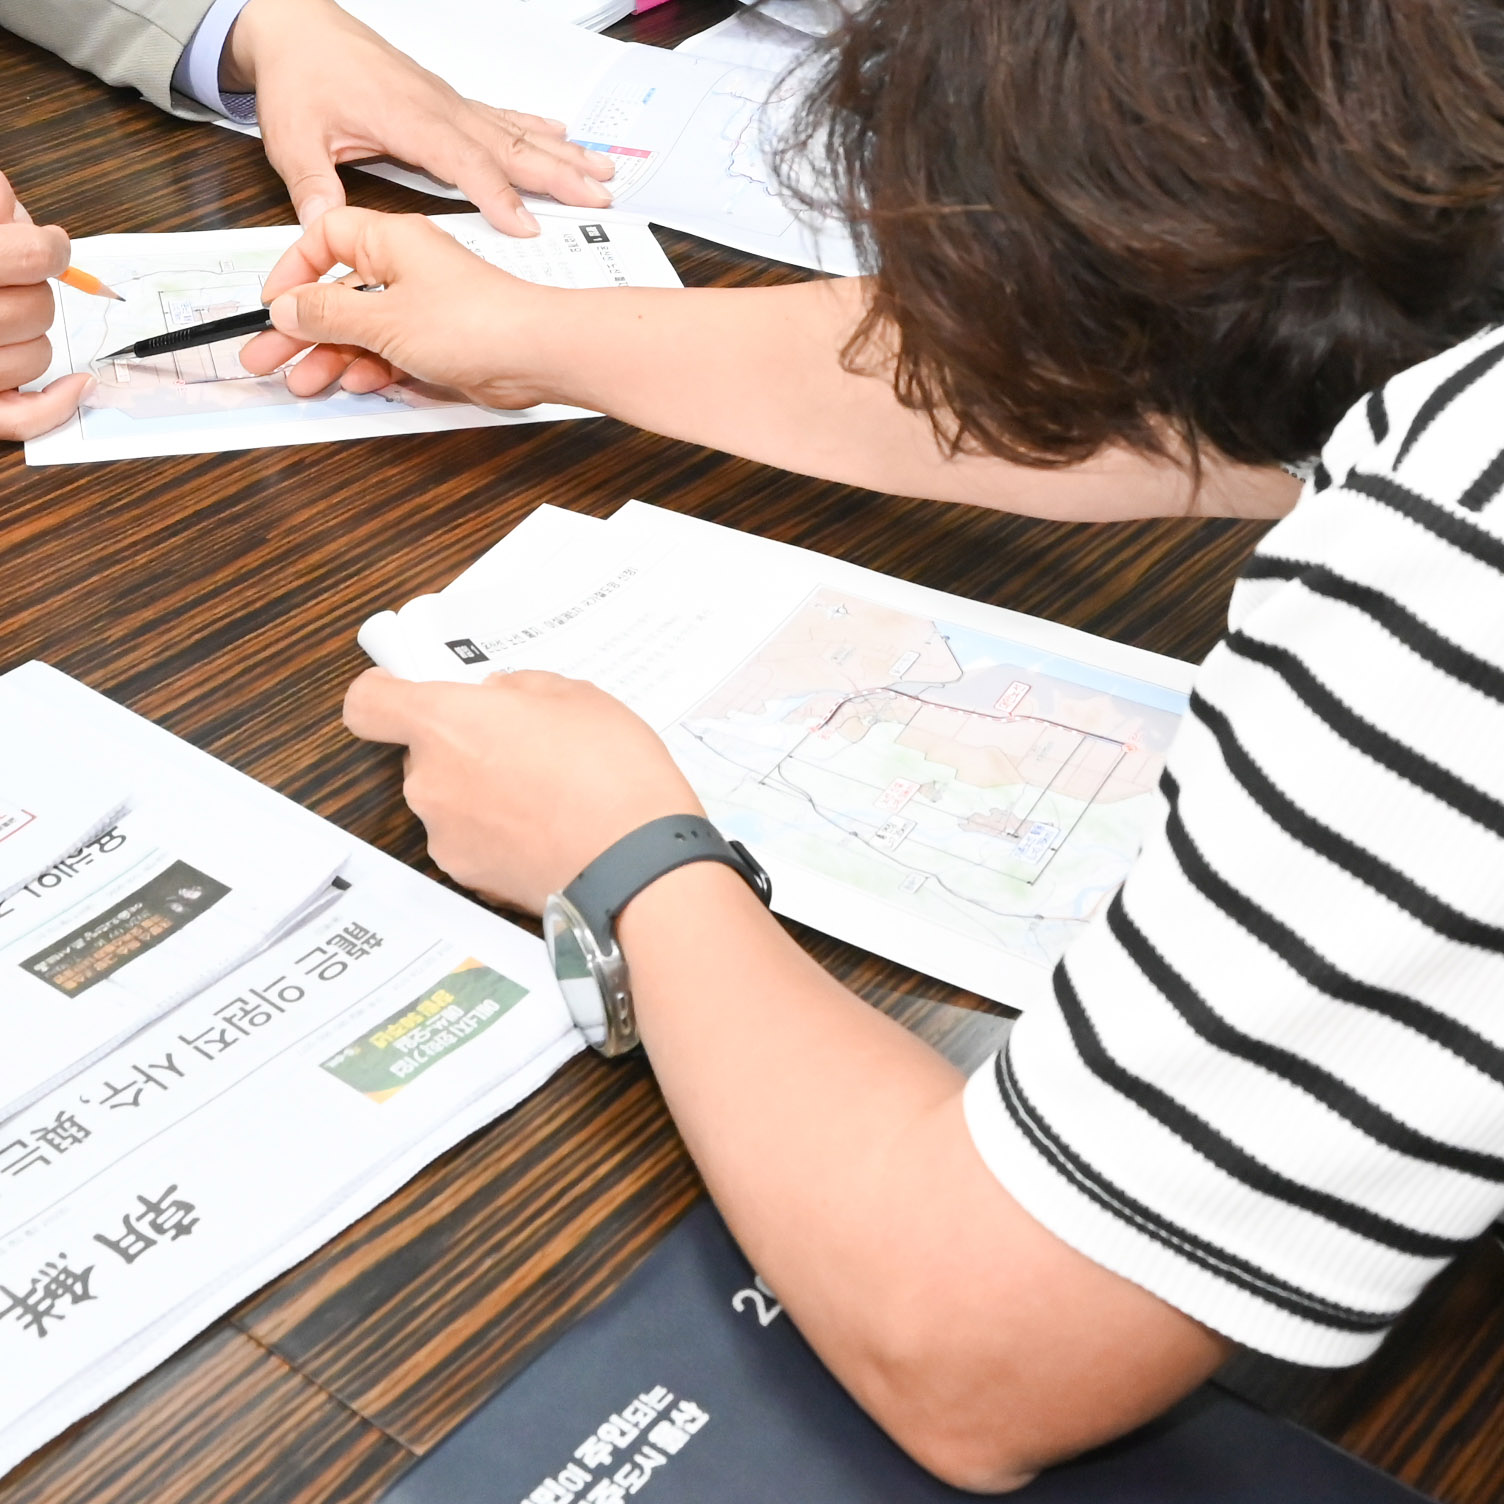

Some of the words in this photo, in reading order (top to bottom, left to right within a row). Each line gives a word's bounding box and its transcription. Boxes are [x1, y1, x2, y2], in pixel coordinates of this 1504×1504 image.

[290, 914, 383, 981] 龍은
[178, 976, 305, 1060] 의원직
[445, 996, 502, 1041] 에너지
[79, 1052, 185, 1110] 사수,
[386, 1046, 426, 1080] 기업
[521, 1463, 592, 1504] 민이
[574, 1386, 673, 1468] 주인되는
[579, 1446, 667, 1504] 주도시
[648, 1400, 709, 1454] 울산
